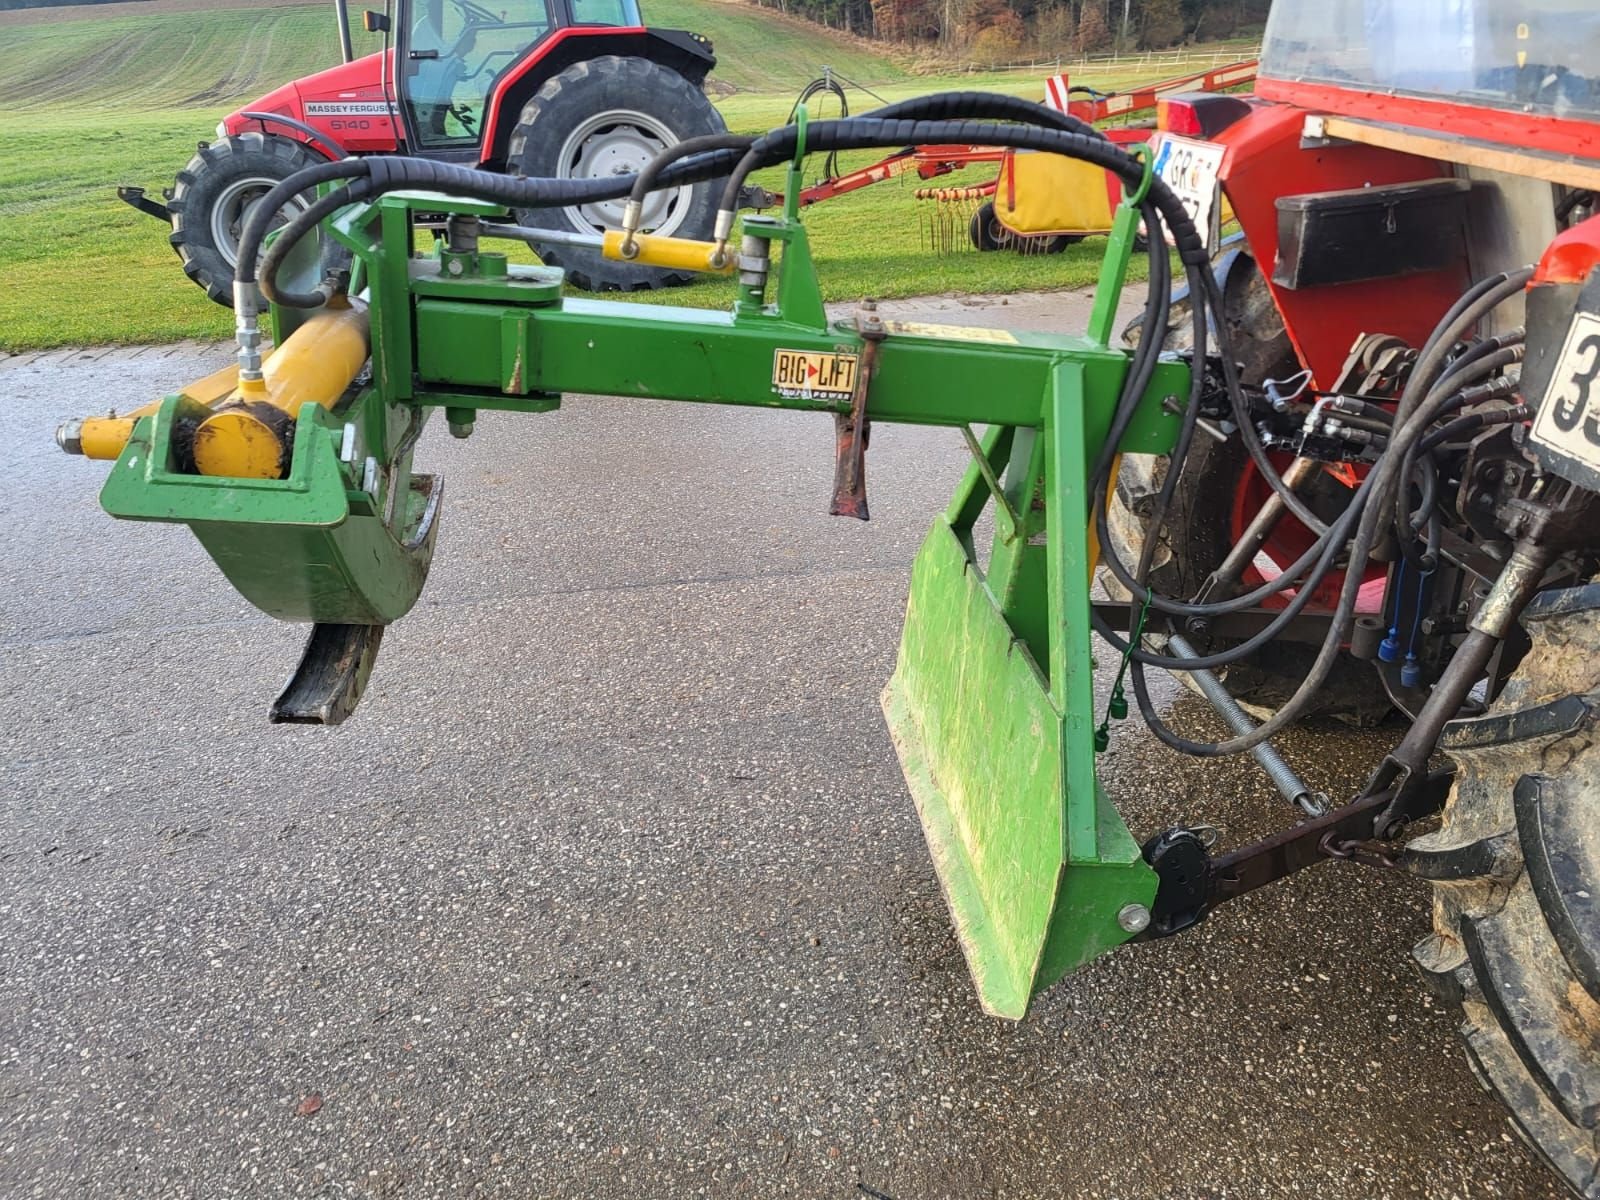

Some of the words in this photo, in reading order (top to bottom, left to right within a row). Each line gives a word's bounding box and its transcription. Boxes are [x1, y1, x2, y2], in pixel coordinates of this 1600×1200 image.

[308, 105, 347, 113] MASSEY
[1171, 149, 1193, 190] GR
[778, 355, 807, 384] BIG
[818, 358, 856, 388] LIFT
[813, 392, 850, 400] POWER
